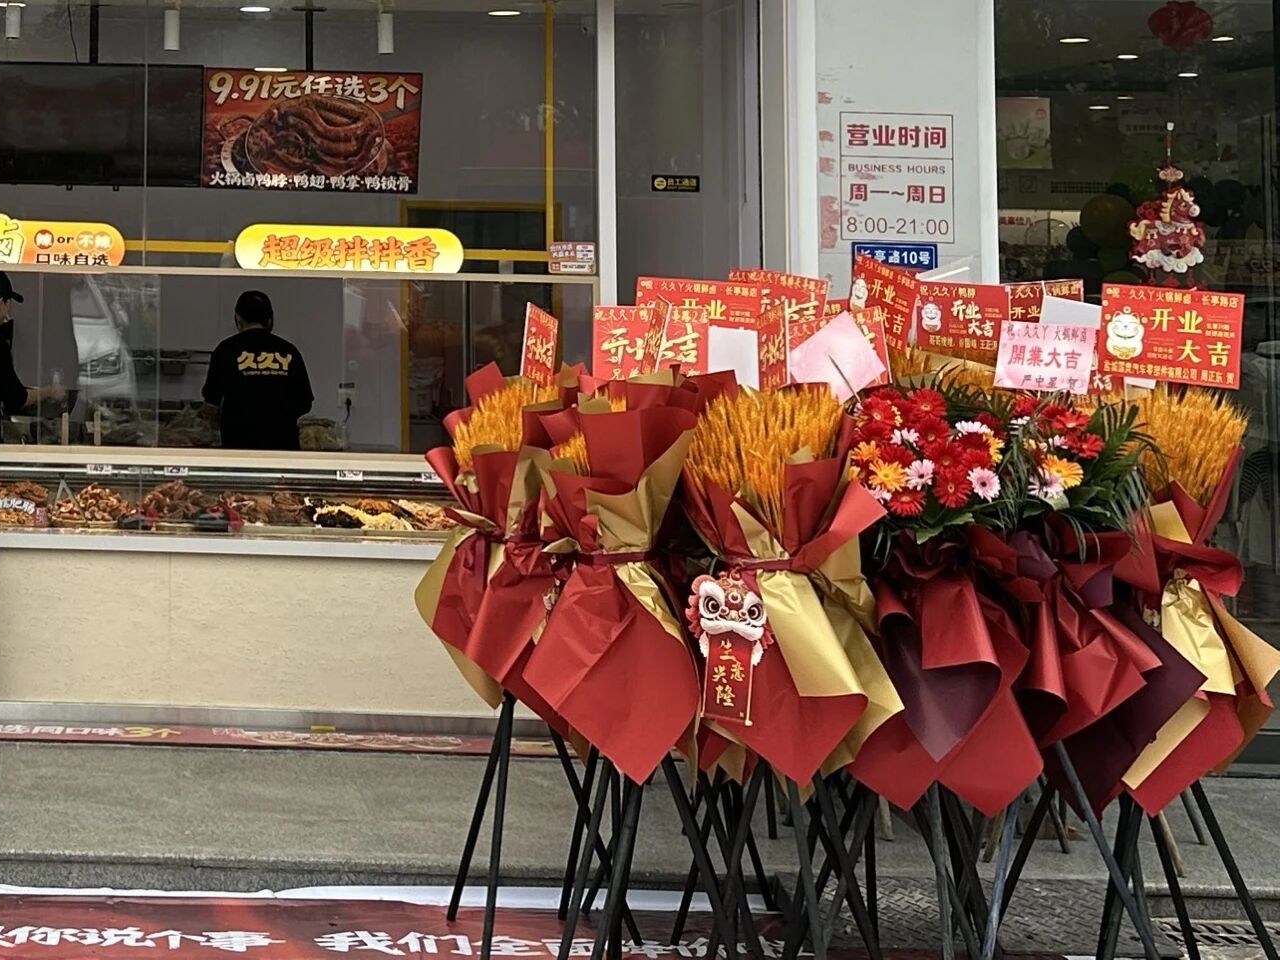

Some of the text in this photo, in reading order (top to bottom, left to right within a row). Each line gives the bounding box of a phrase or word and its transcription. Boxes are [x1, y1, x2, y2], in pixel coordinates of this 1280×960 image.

[846, 124, 948, 149] 营业时间
[848, 163, 946, 176] BUSINESS HOURS
[846, 217, 950, 237] 8:00-21:00
[36, 253, 109, 266] 口味自选
[260, 233, 439, 272] 超级拌拌香
[968, 319, 996, 338] 大吉
[1149, 308, 1204, 335] 开业
[1008, 344, 1083, 370] 開業大吉
[1176, 339, 1232, 368] 大吉
